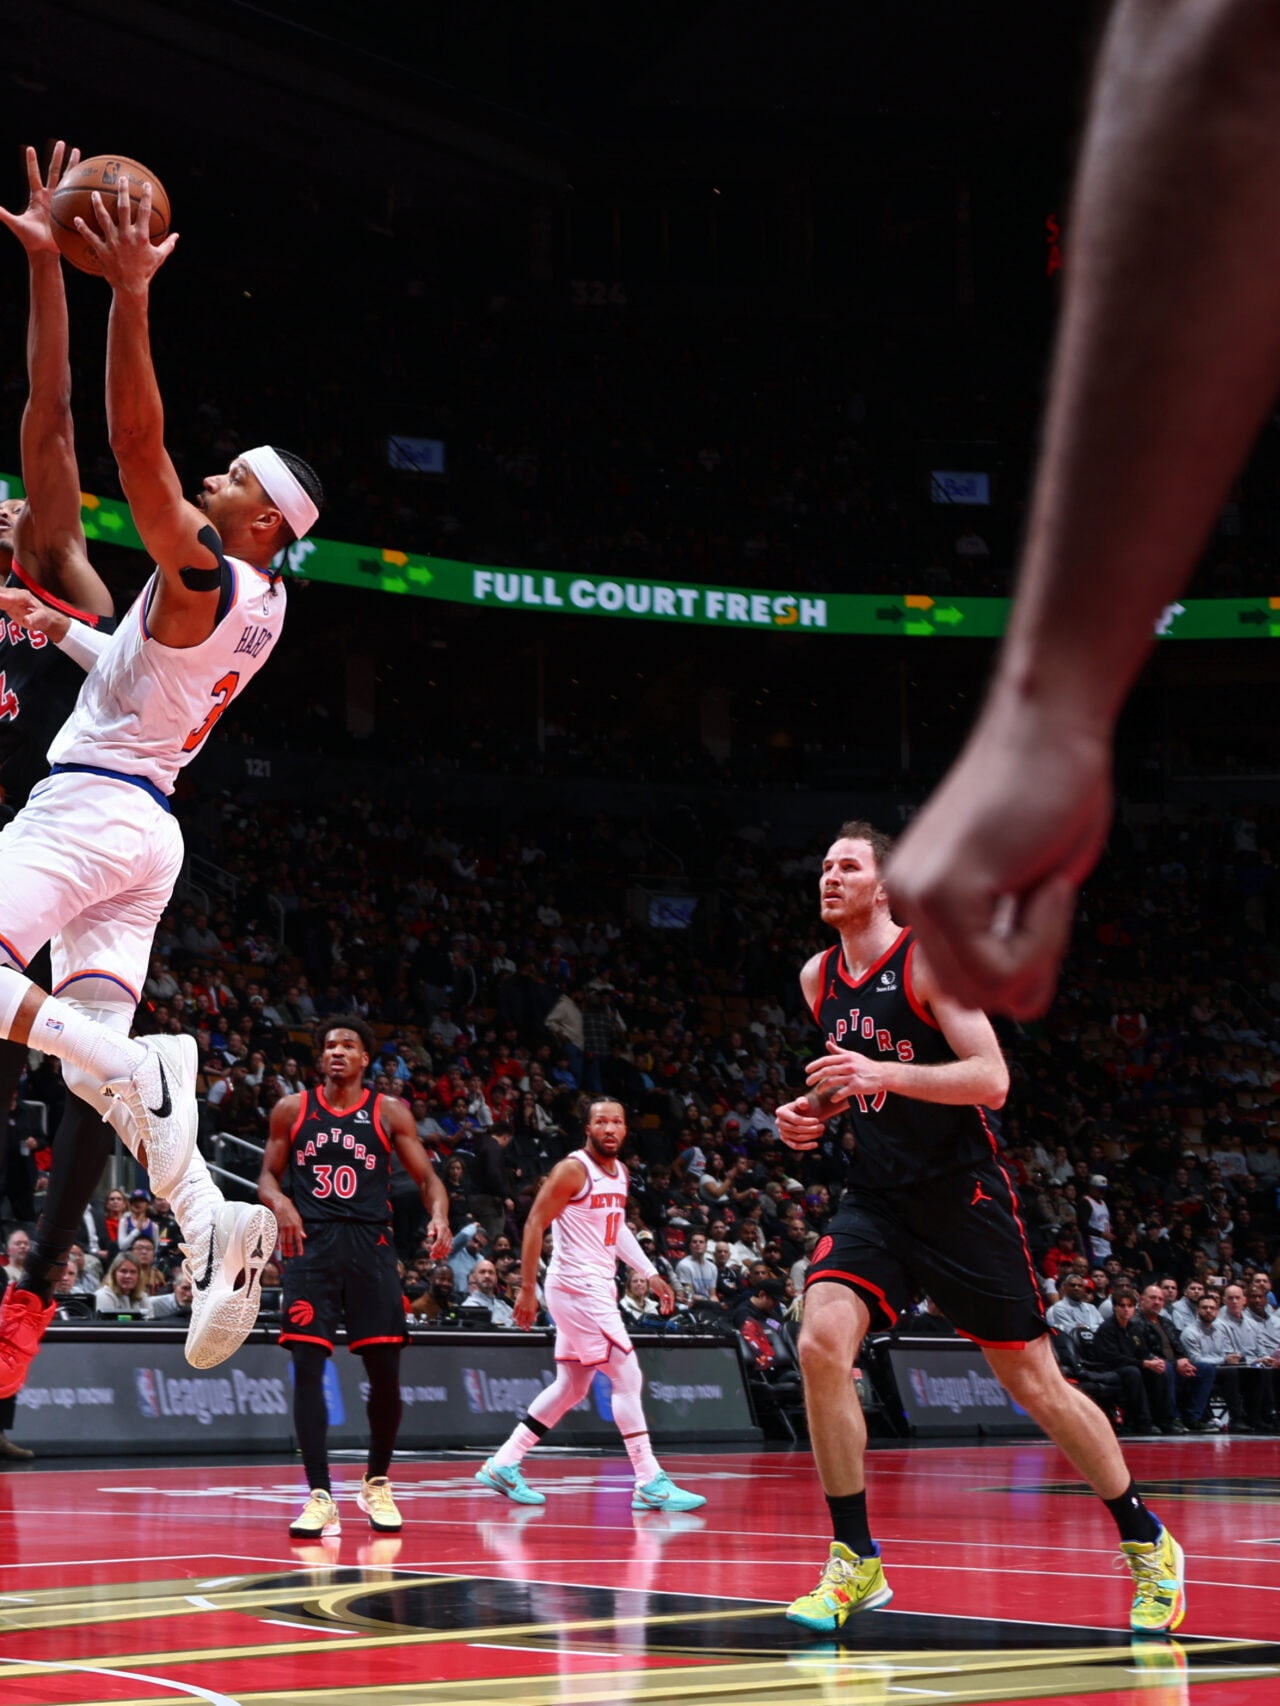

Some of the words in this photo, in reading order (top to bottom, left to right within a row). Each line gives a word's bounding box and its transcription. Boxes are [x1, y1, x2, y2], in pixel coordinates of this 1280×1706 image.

[473, 569, 564, 606] FULL
[569, 579, 699, 617] COURT
[705, 590, 828, 627] FRESH
[234, 625, 272, 658] HART
[181, 671, 240, 753] 3
[245, 757, 271, 779] 121
[296, 1127, 376, 1170] RAPTORS
[311, 1164, 357, 1199] 30
[604, 1212, 621, 1247] 11
[153, 1368, 236, 1425] League
[231, 1368, 288, 1416] Pass
